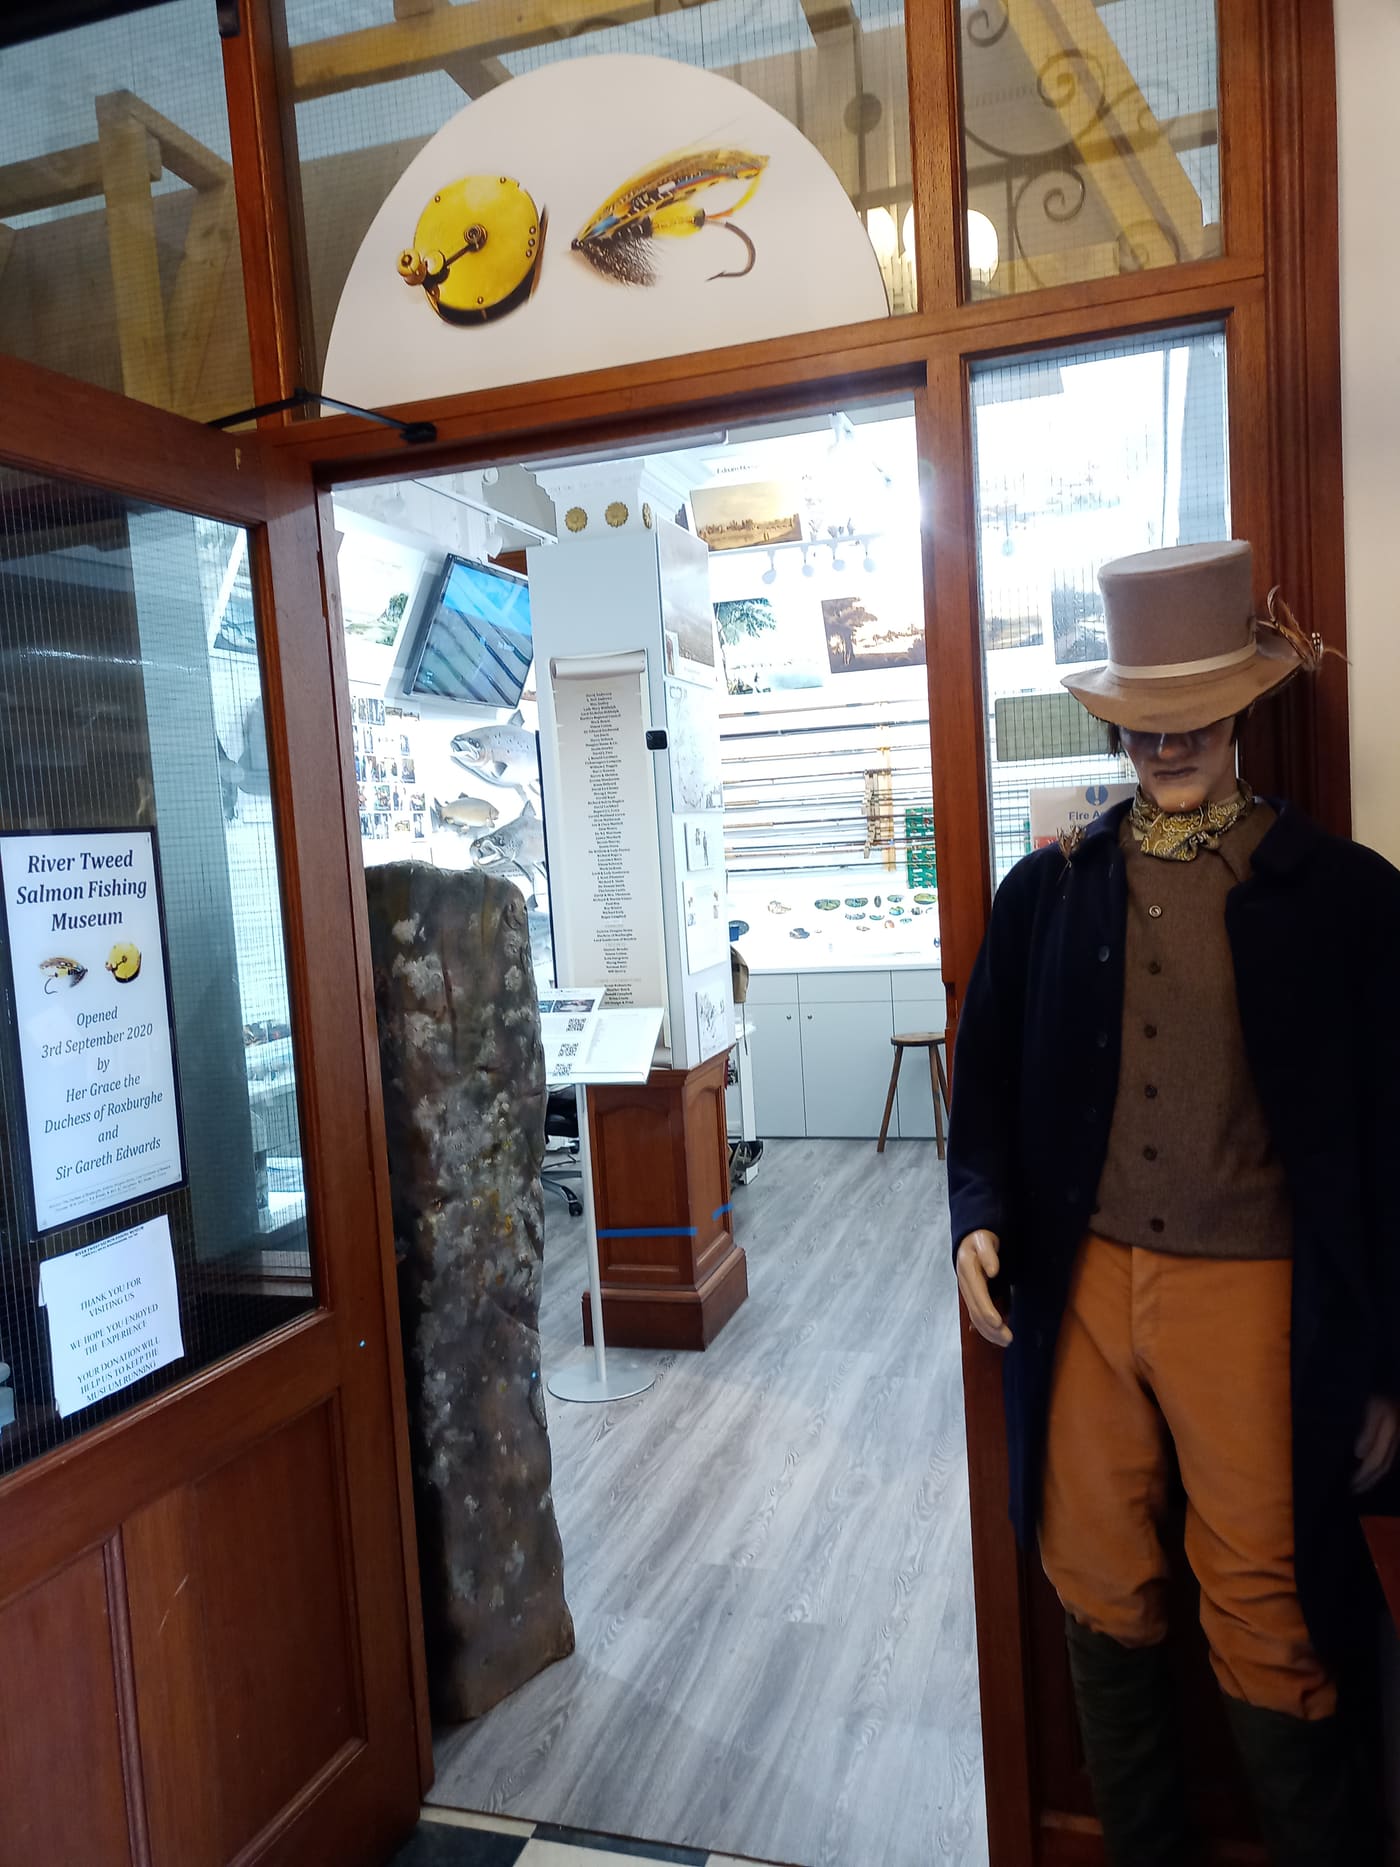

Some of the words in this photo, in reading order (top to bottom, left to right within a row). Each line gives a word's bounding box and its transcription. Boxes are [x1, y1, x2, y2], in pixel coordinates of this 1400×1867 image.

[1069, 811, 1089, 820] Fire
[28, 854, 75, 873] River
[80, 850, 134, 870] Tweed
[17, 884, 83, 904] Salmon
[88, 878, 147, 899] Fishing
[51, 911, 123, 931] Museum
[77, 1006, 118, 1028] Opened
[41, 1044, 62, 1059] 3rd
[65, 1030, 125, 1054] September
[127, 1023, 153, 1041] 2020
[97, 1057, 110, 1073] by
[66, 1087, 87, 1103] Her
[90, 1079, 121, 1097] Grace
[124, 1073, 140, 1087] the
[44, 1111, 91, 1134] Duchess
[94, 1105, 107, 1122] of
[107, 1090, 163, 1116] Roxburghe
[97, 1125, 119, 1143] and
[56, 1165, 72, 1181] Sir
[75, 1152, 113, 1174] Gareth
[116, 1136, 161, 1162] Edwards
[80, 1293, 107, 1311] THANK
[108, 1284, 125, 1298] YOU
[126, 1277, 142, 1290] FOR
[89, 1298, 123, 1317] VISITING
[124, 1292, 135, 1302] US
[84, 1328, 104, 1345] HOPE
[106, 1320, 123, 1334] YOU
[125, 1303, 159, 1326] ENJOYED
[77, 1366, 100, 1384] YOUR
[100, 1345, 141, 1371] DONATION
[141, 1337, 160, 1351] WILL
[123, 1361, 156, 1385] RUNNING
[102, 1373, 112, 1383] US
[114, 1366, 125, 1377] TO
